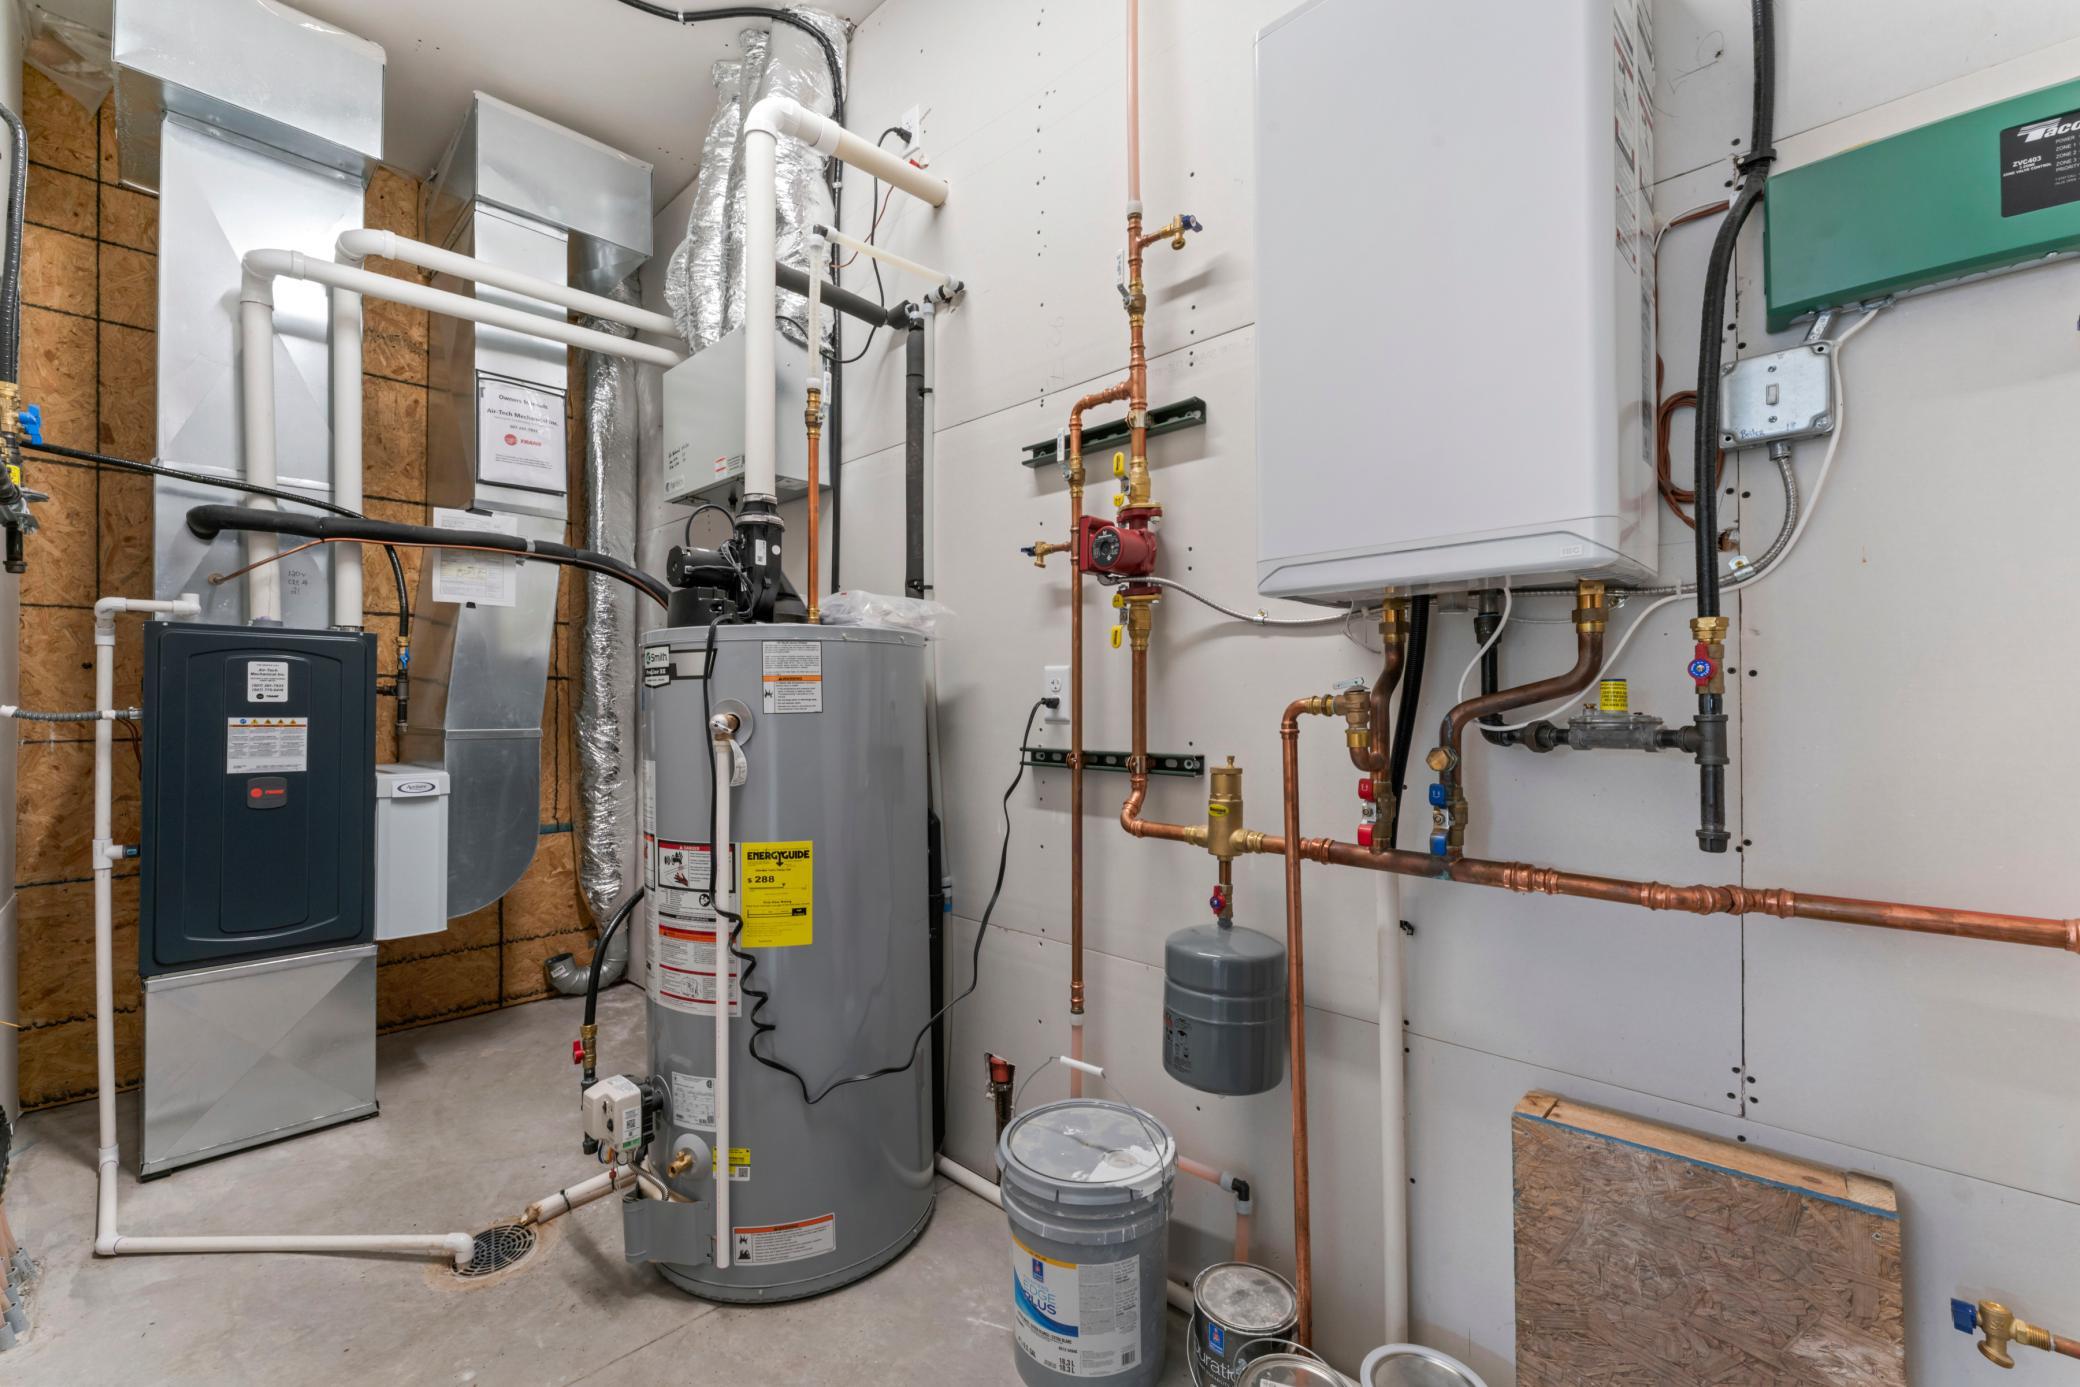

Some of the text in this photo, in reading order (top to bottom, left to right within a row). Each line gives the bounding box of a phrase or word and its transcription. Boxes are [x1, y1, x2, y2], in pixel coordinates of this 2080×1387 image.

[2017, 117, 2080, 143] Taco
[2055, 144, 2072, 152] ZONE
[2055, 151, 2072, 159] ZONE
[2012, 155, 2042, 168] ZVC403
[2055, 159, 2072, 167] ZONE
[498, 394, 522, 404] Owners
[487, 407, 513, 417] Air-Tech
[747, 849, 810, 862] ENERGYGUIDE
[754, 875, 775, 884] 288
[1024, 1279, 1057, 1304] EDGE
[1024, 1290, 1057, 1315] PLUS
